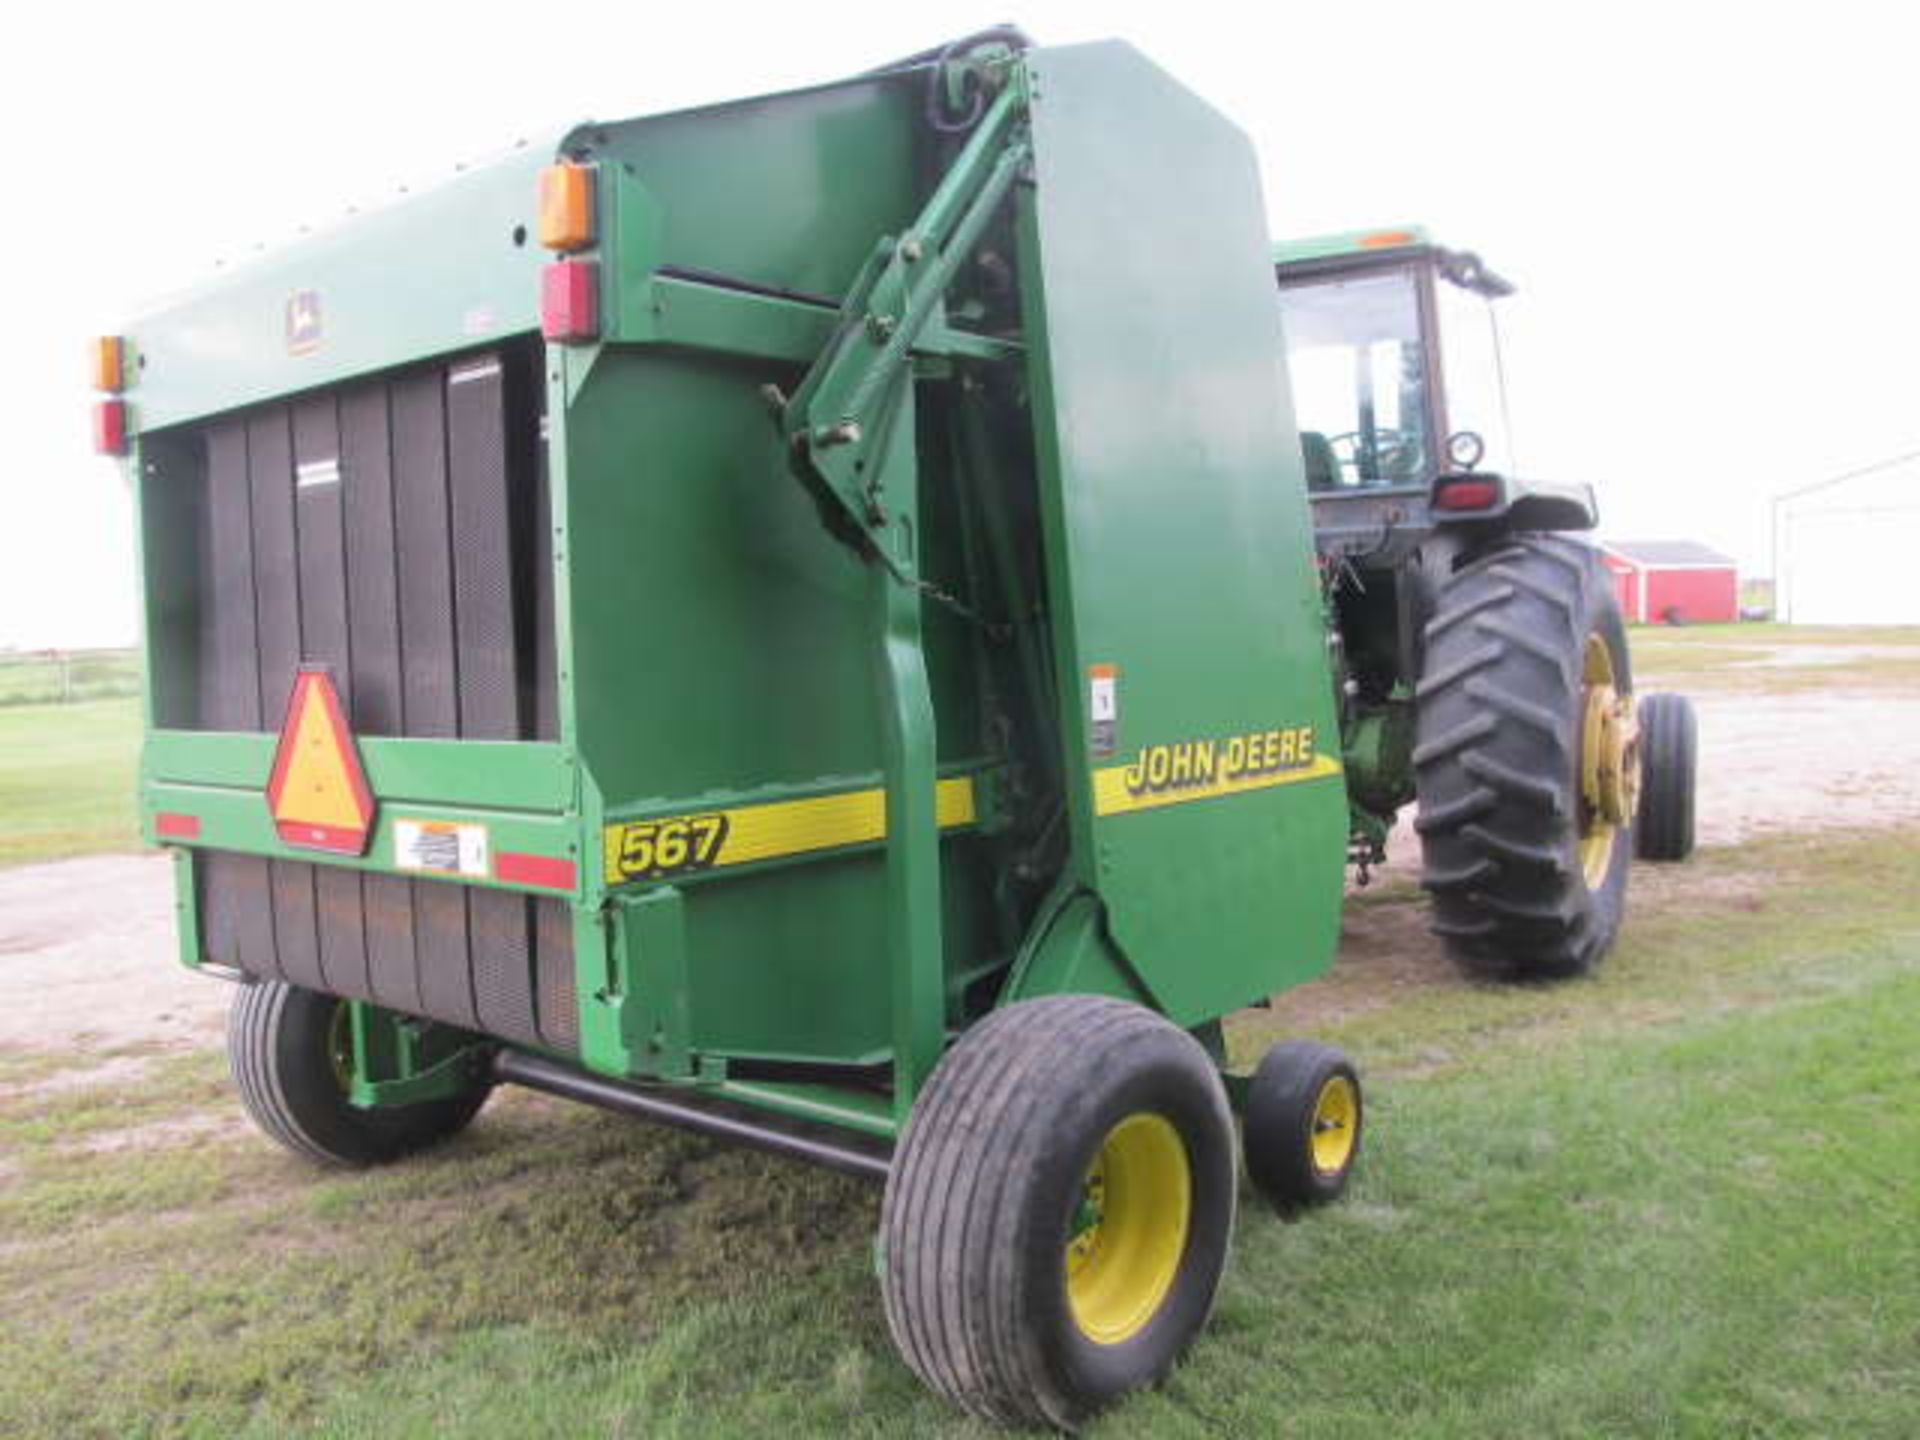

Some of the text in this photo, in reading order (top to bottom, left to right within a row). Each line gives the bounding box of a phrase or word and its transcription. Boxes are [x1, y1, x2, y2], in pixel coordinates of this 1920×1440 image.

[1126, 727, 1314, 793] JOHN DEERE
[620, 815, 727, 874] 567
